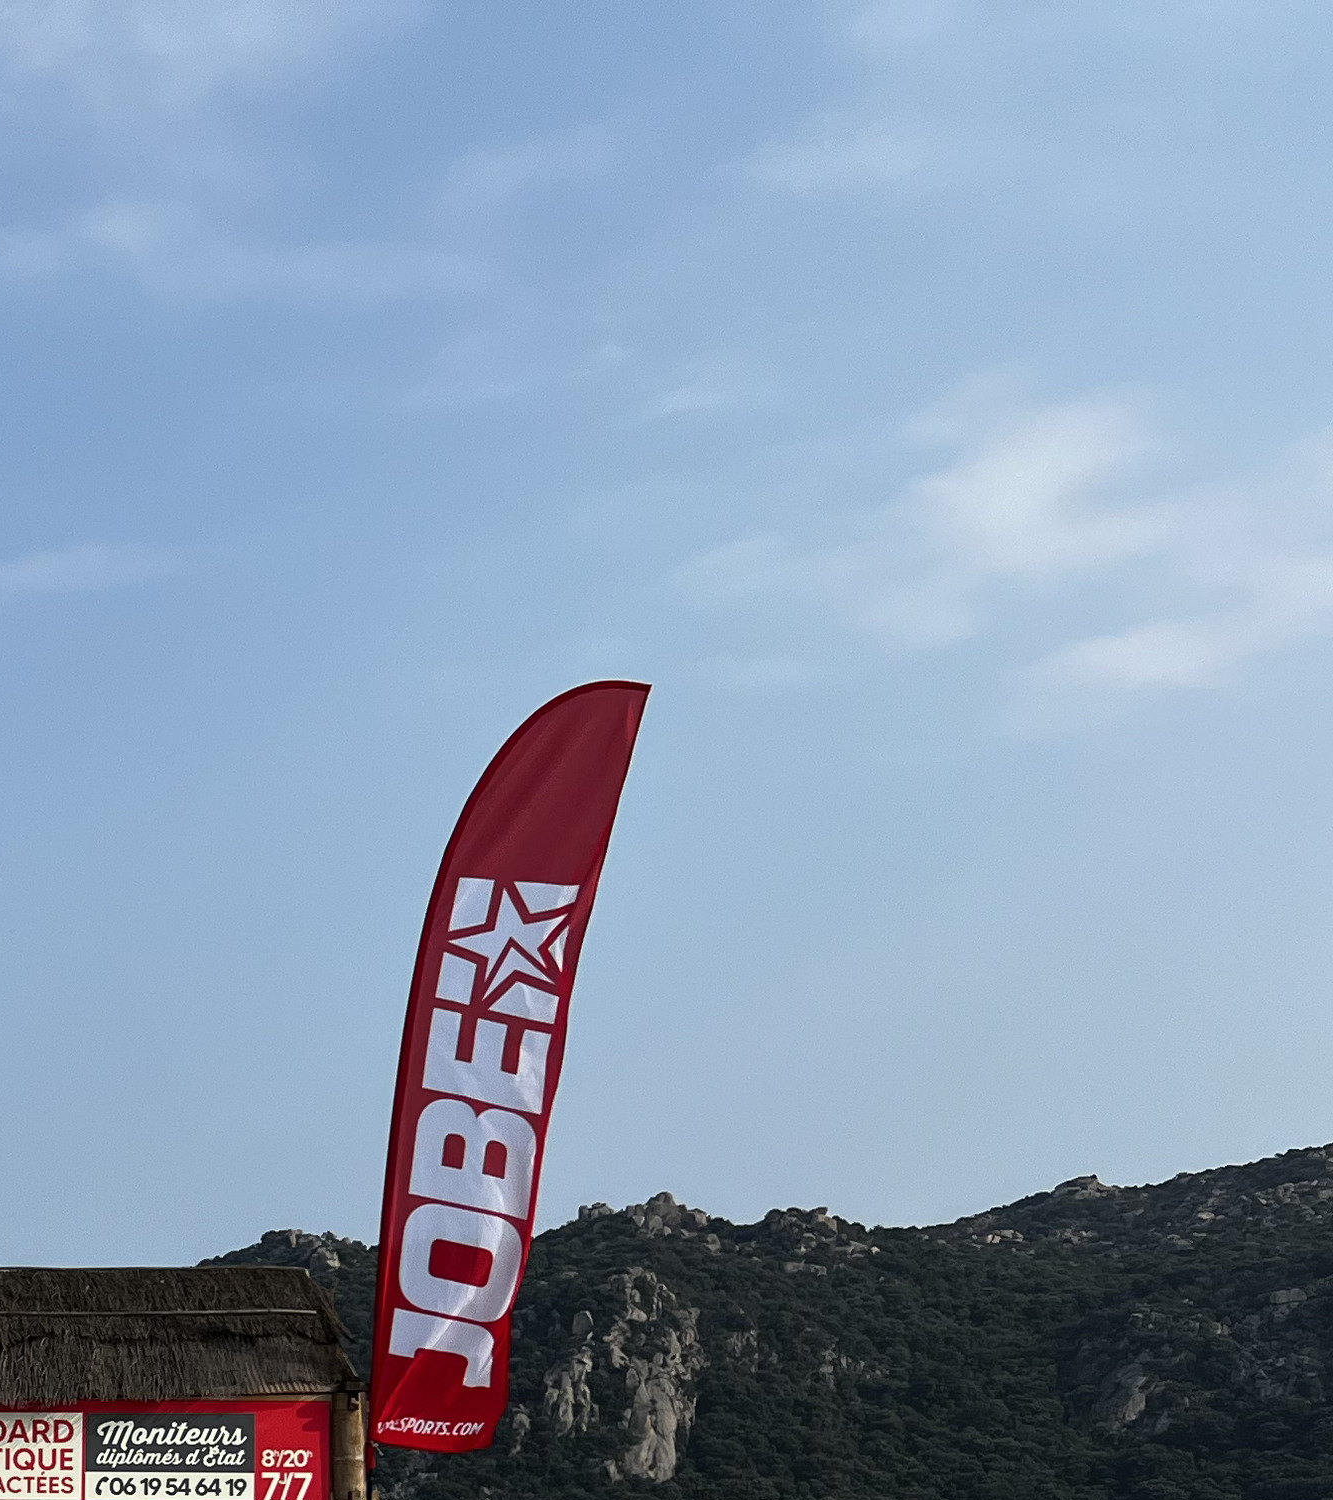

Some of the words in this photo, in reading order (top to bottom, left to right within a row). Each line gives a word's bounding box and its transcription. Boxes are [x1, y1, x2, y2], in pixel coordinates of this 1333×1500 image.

[388, 1008, 552, 1389] JOBE
[96, 1420, 247, 1450] Moniteurs
[377, 1416, 485, 1436] SPORTS.COM
[96, 1449, 183, 1468] diplômés
[109, 1477, 136, 1496] 06
[141, 1478, 162, 1496] 19
[165, 1478, 191, 1496] 54
[195, 1478, 221, 1497] 64
[225, 1478, 247, 1497] 19
